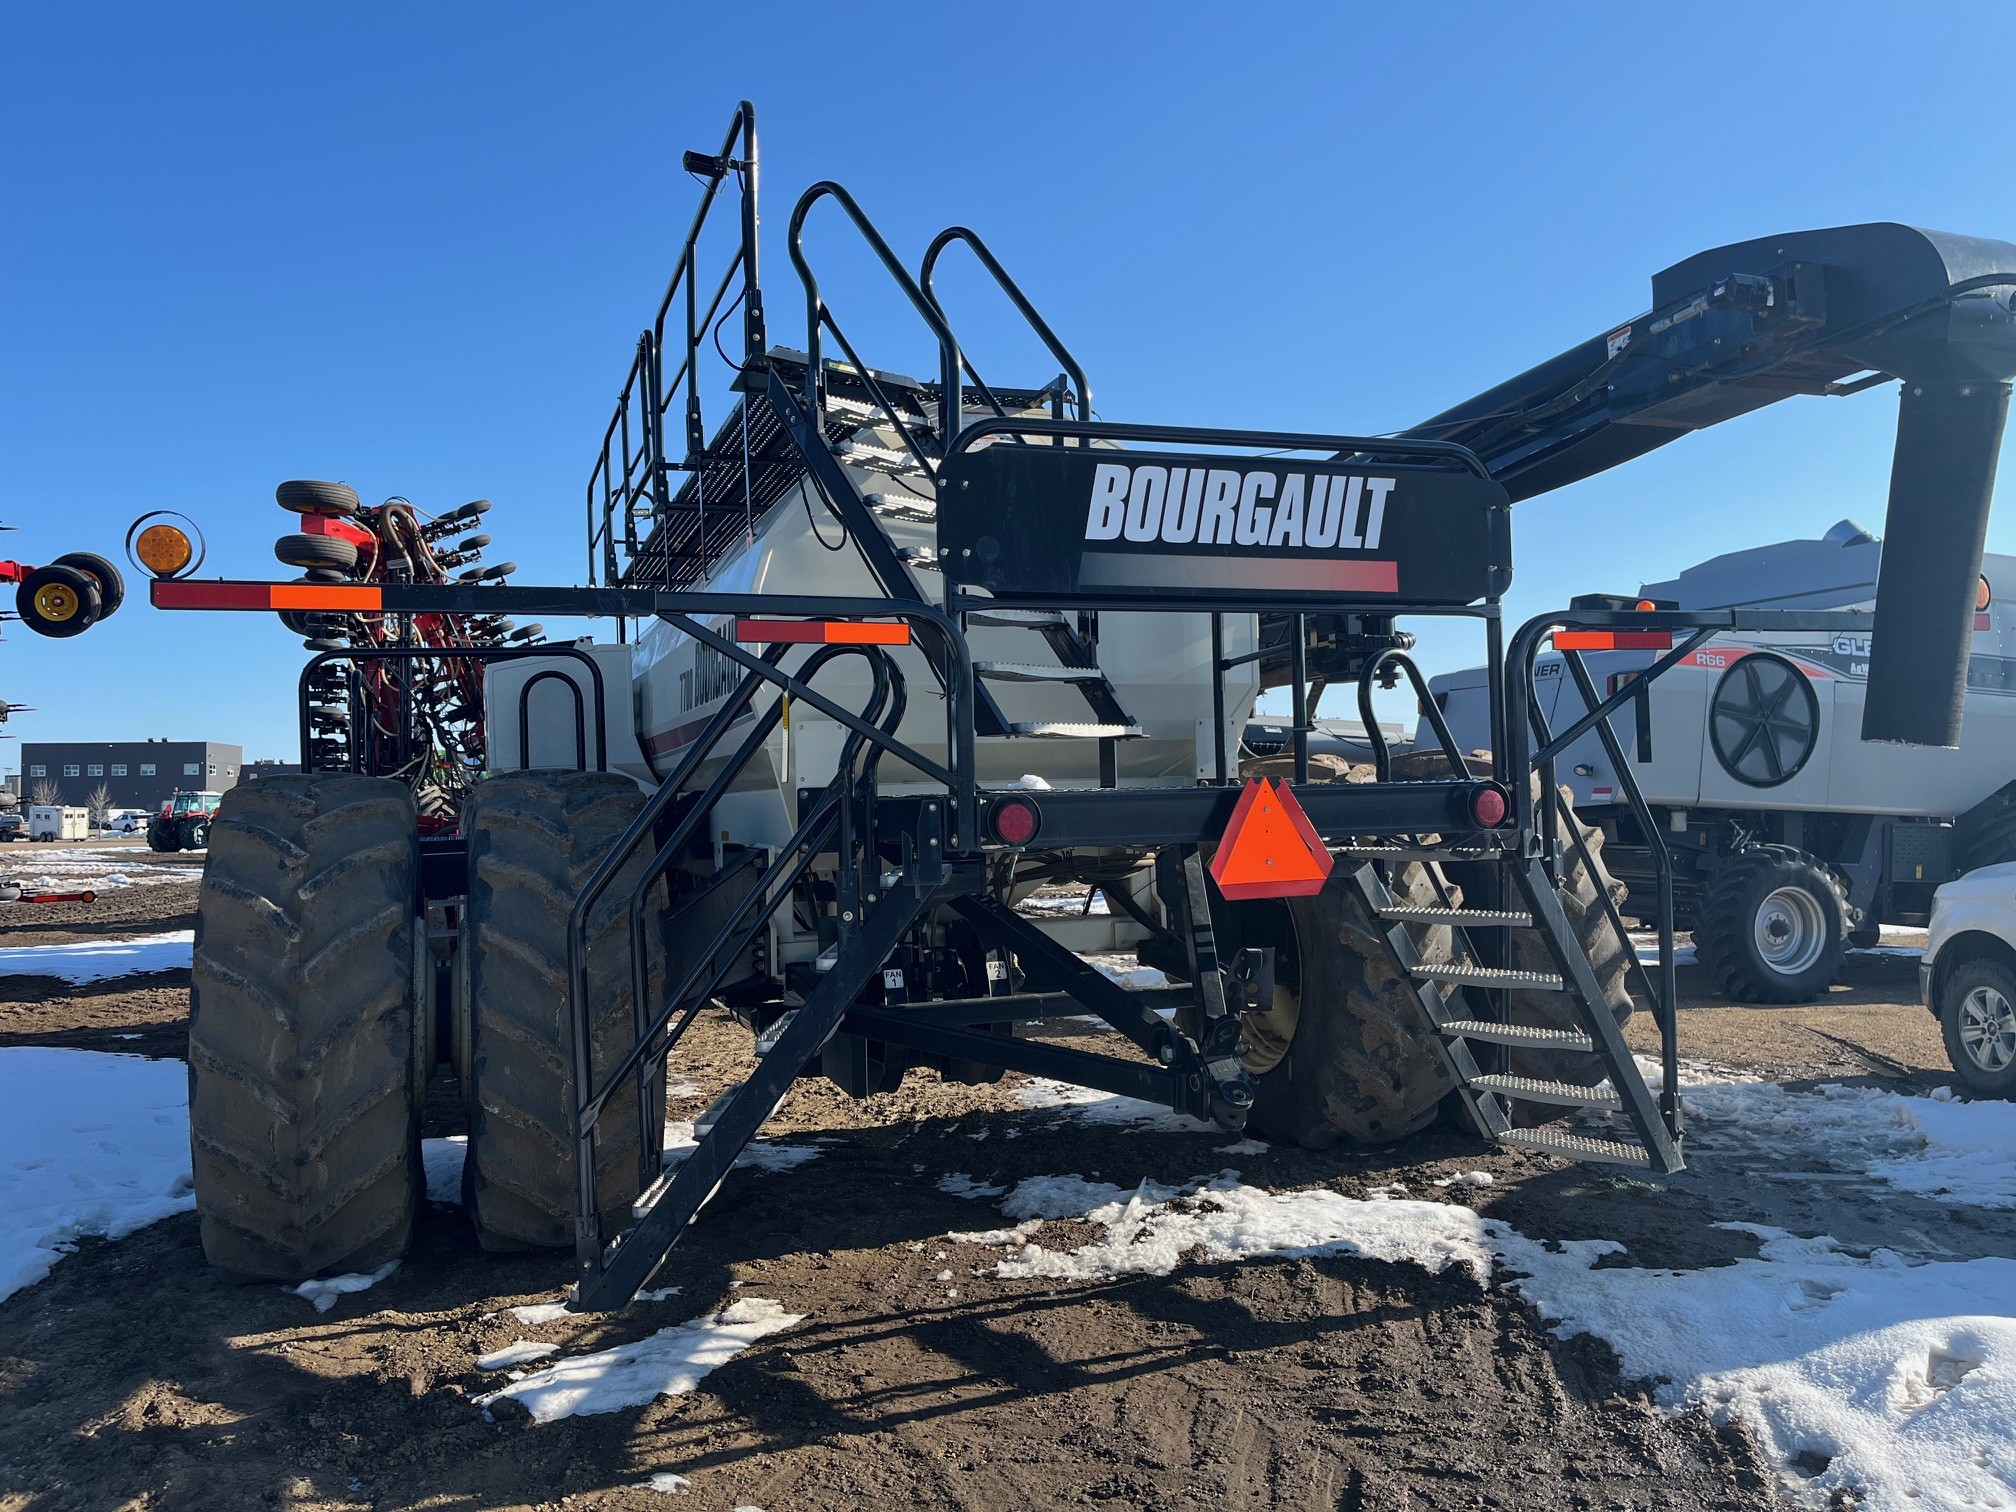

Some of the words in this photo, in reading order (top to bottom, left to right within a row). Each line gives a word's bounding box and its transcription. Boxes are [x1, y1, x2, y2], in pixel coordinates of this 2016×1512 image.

[1084, 463, 1397, 549] BOURGAULT
[1833, 637, 1871, 657] GLE
[694, 617, 742, 708] BOURGAUL
[1696, 653, 1726, 667] R66
[885, 971, 902, 979] FAN
[995, 970, 1001, 978] 2
[891, 978, 897, 987] 1
